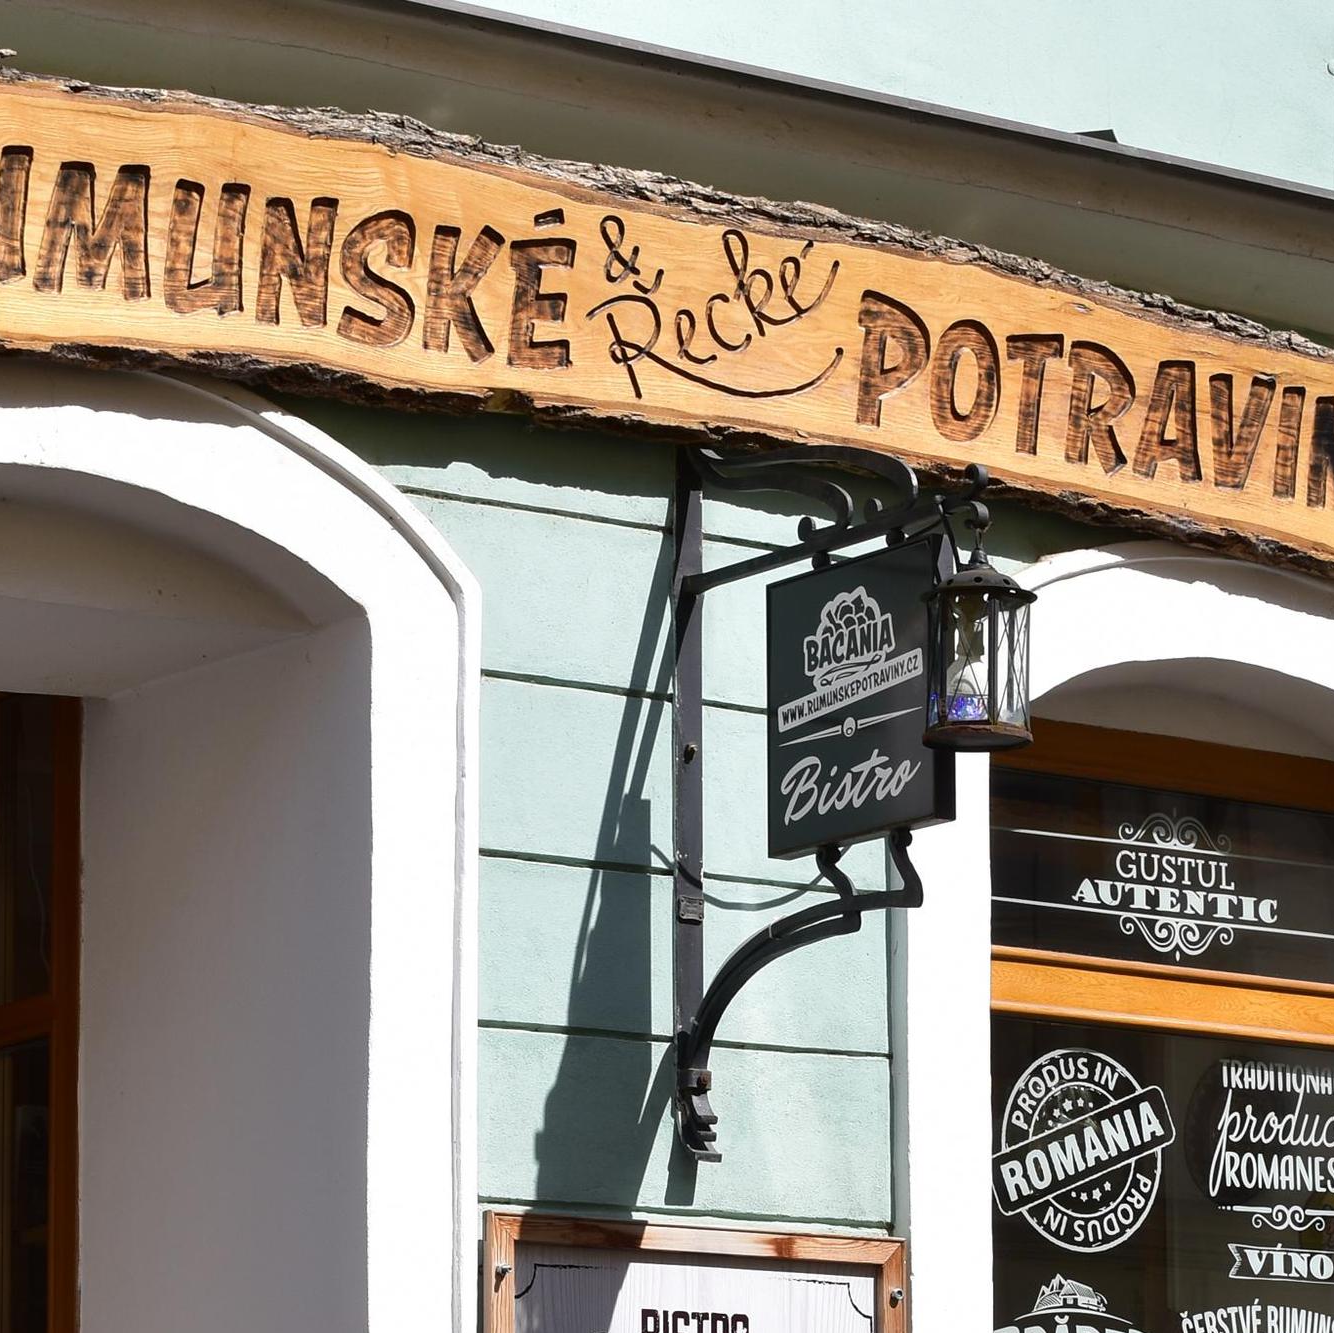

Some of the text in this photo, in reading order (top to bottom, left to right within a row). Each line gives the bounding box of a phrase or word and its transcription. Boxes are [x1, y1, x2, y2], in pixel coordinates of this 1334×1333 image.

[601, 216, 641, 284] &
[586, 229, 841, 399] Řecké
[807, 616, 893, 672] BACANIA
[782, 654, 919, 726] WWW.RUMUNSKEPOTRAVINY.CZ
[781, 750, 921, 826] Bistro
[1072, 878, 1278, 924] AUTENTIC
[1116, 850, 1235, 890] GUSTUL
[1011, 1057, 1120, 1130] PRODUS IN
[1000, 1100, 1164, 1202] ROMANIA
[1044, 1173, 1152, 1243] PRODUS IN
